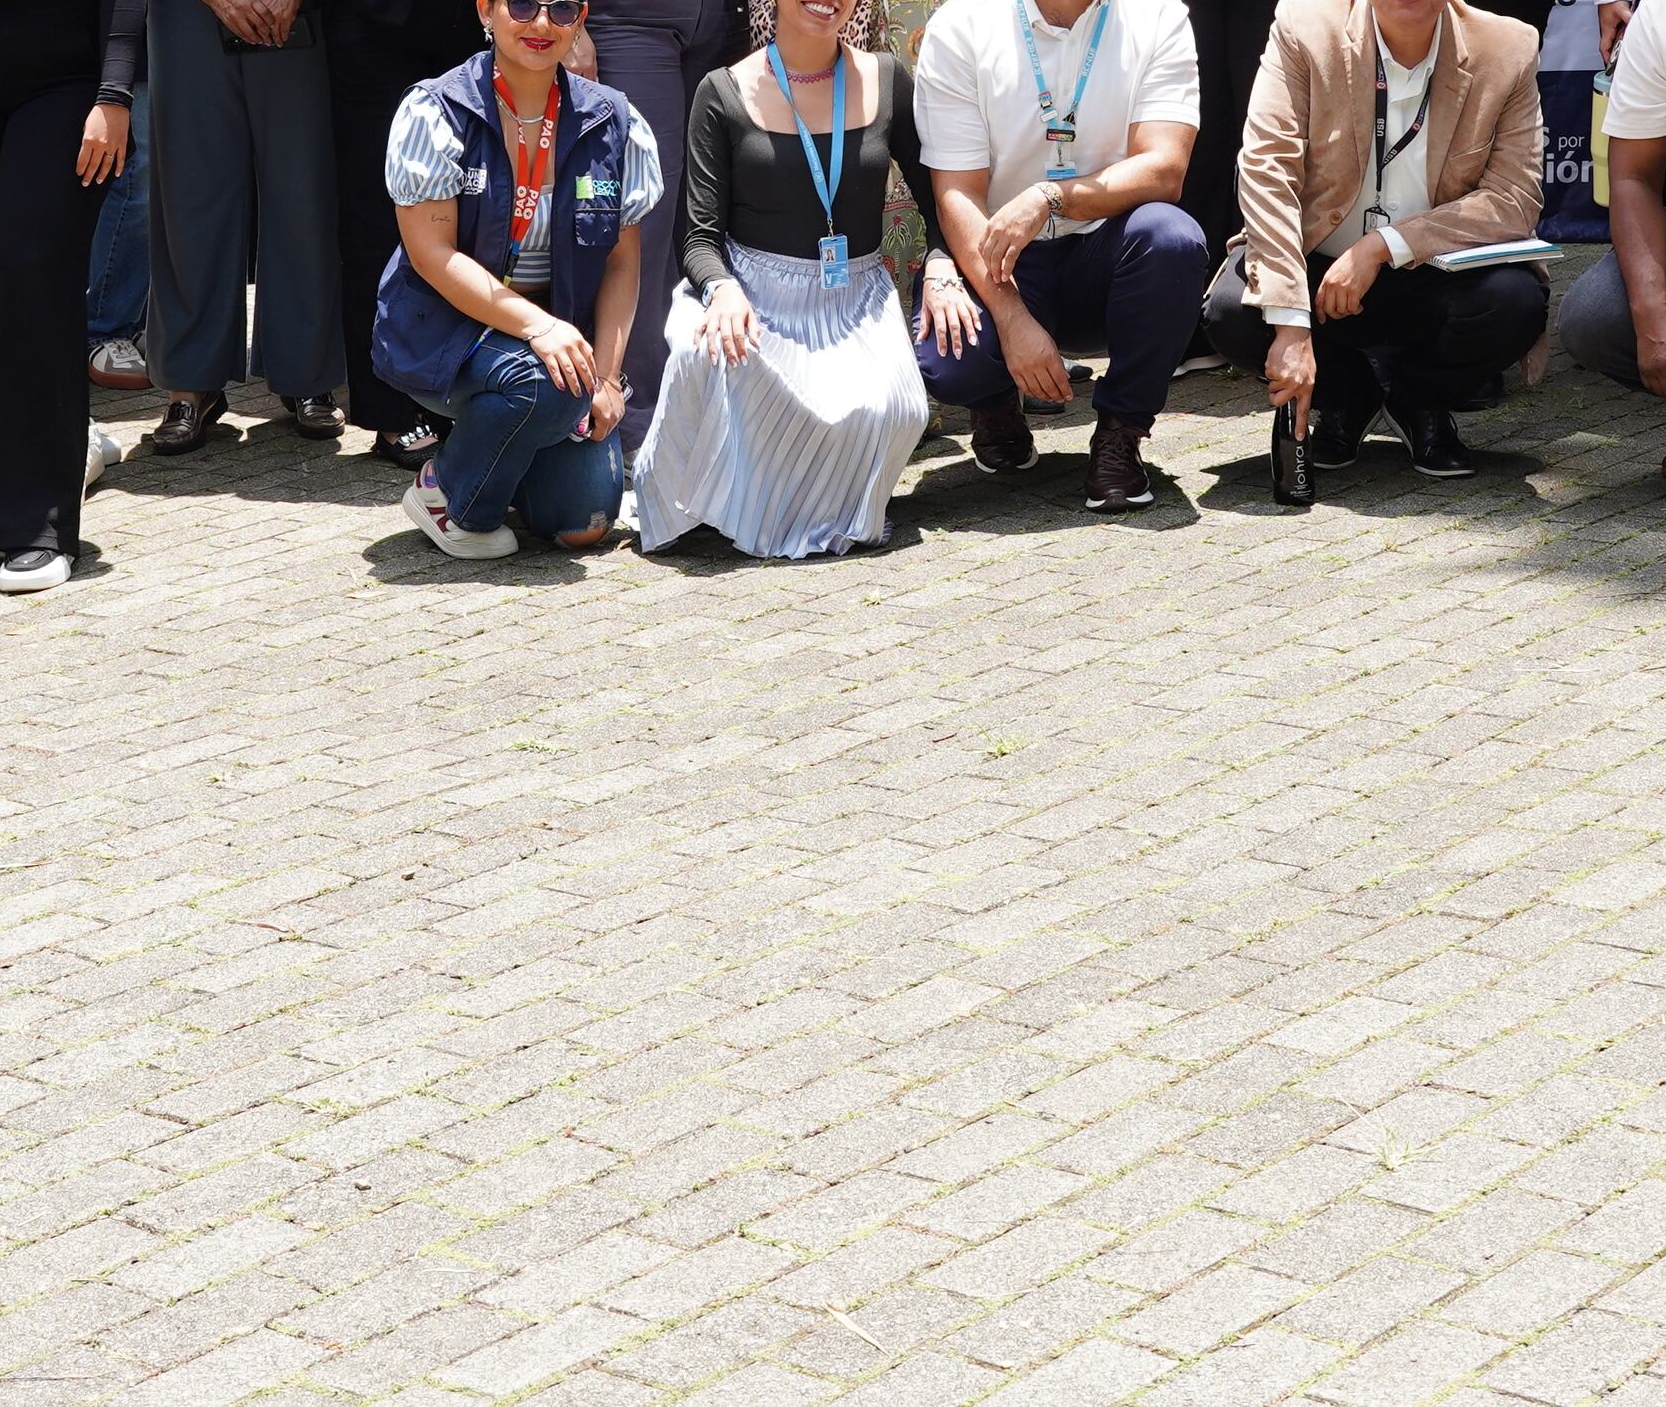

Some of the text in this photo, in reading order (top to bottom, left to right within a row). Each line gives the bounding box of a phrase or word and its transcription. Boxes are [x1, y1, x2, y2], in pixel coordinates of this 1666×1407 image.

[539, 118, 554, 150] PAO
[1376, 117, 1386, 137] USB
[1558, 136, 1586, 151] por
